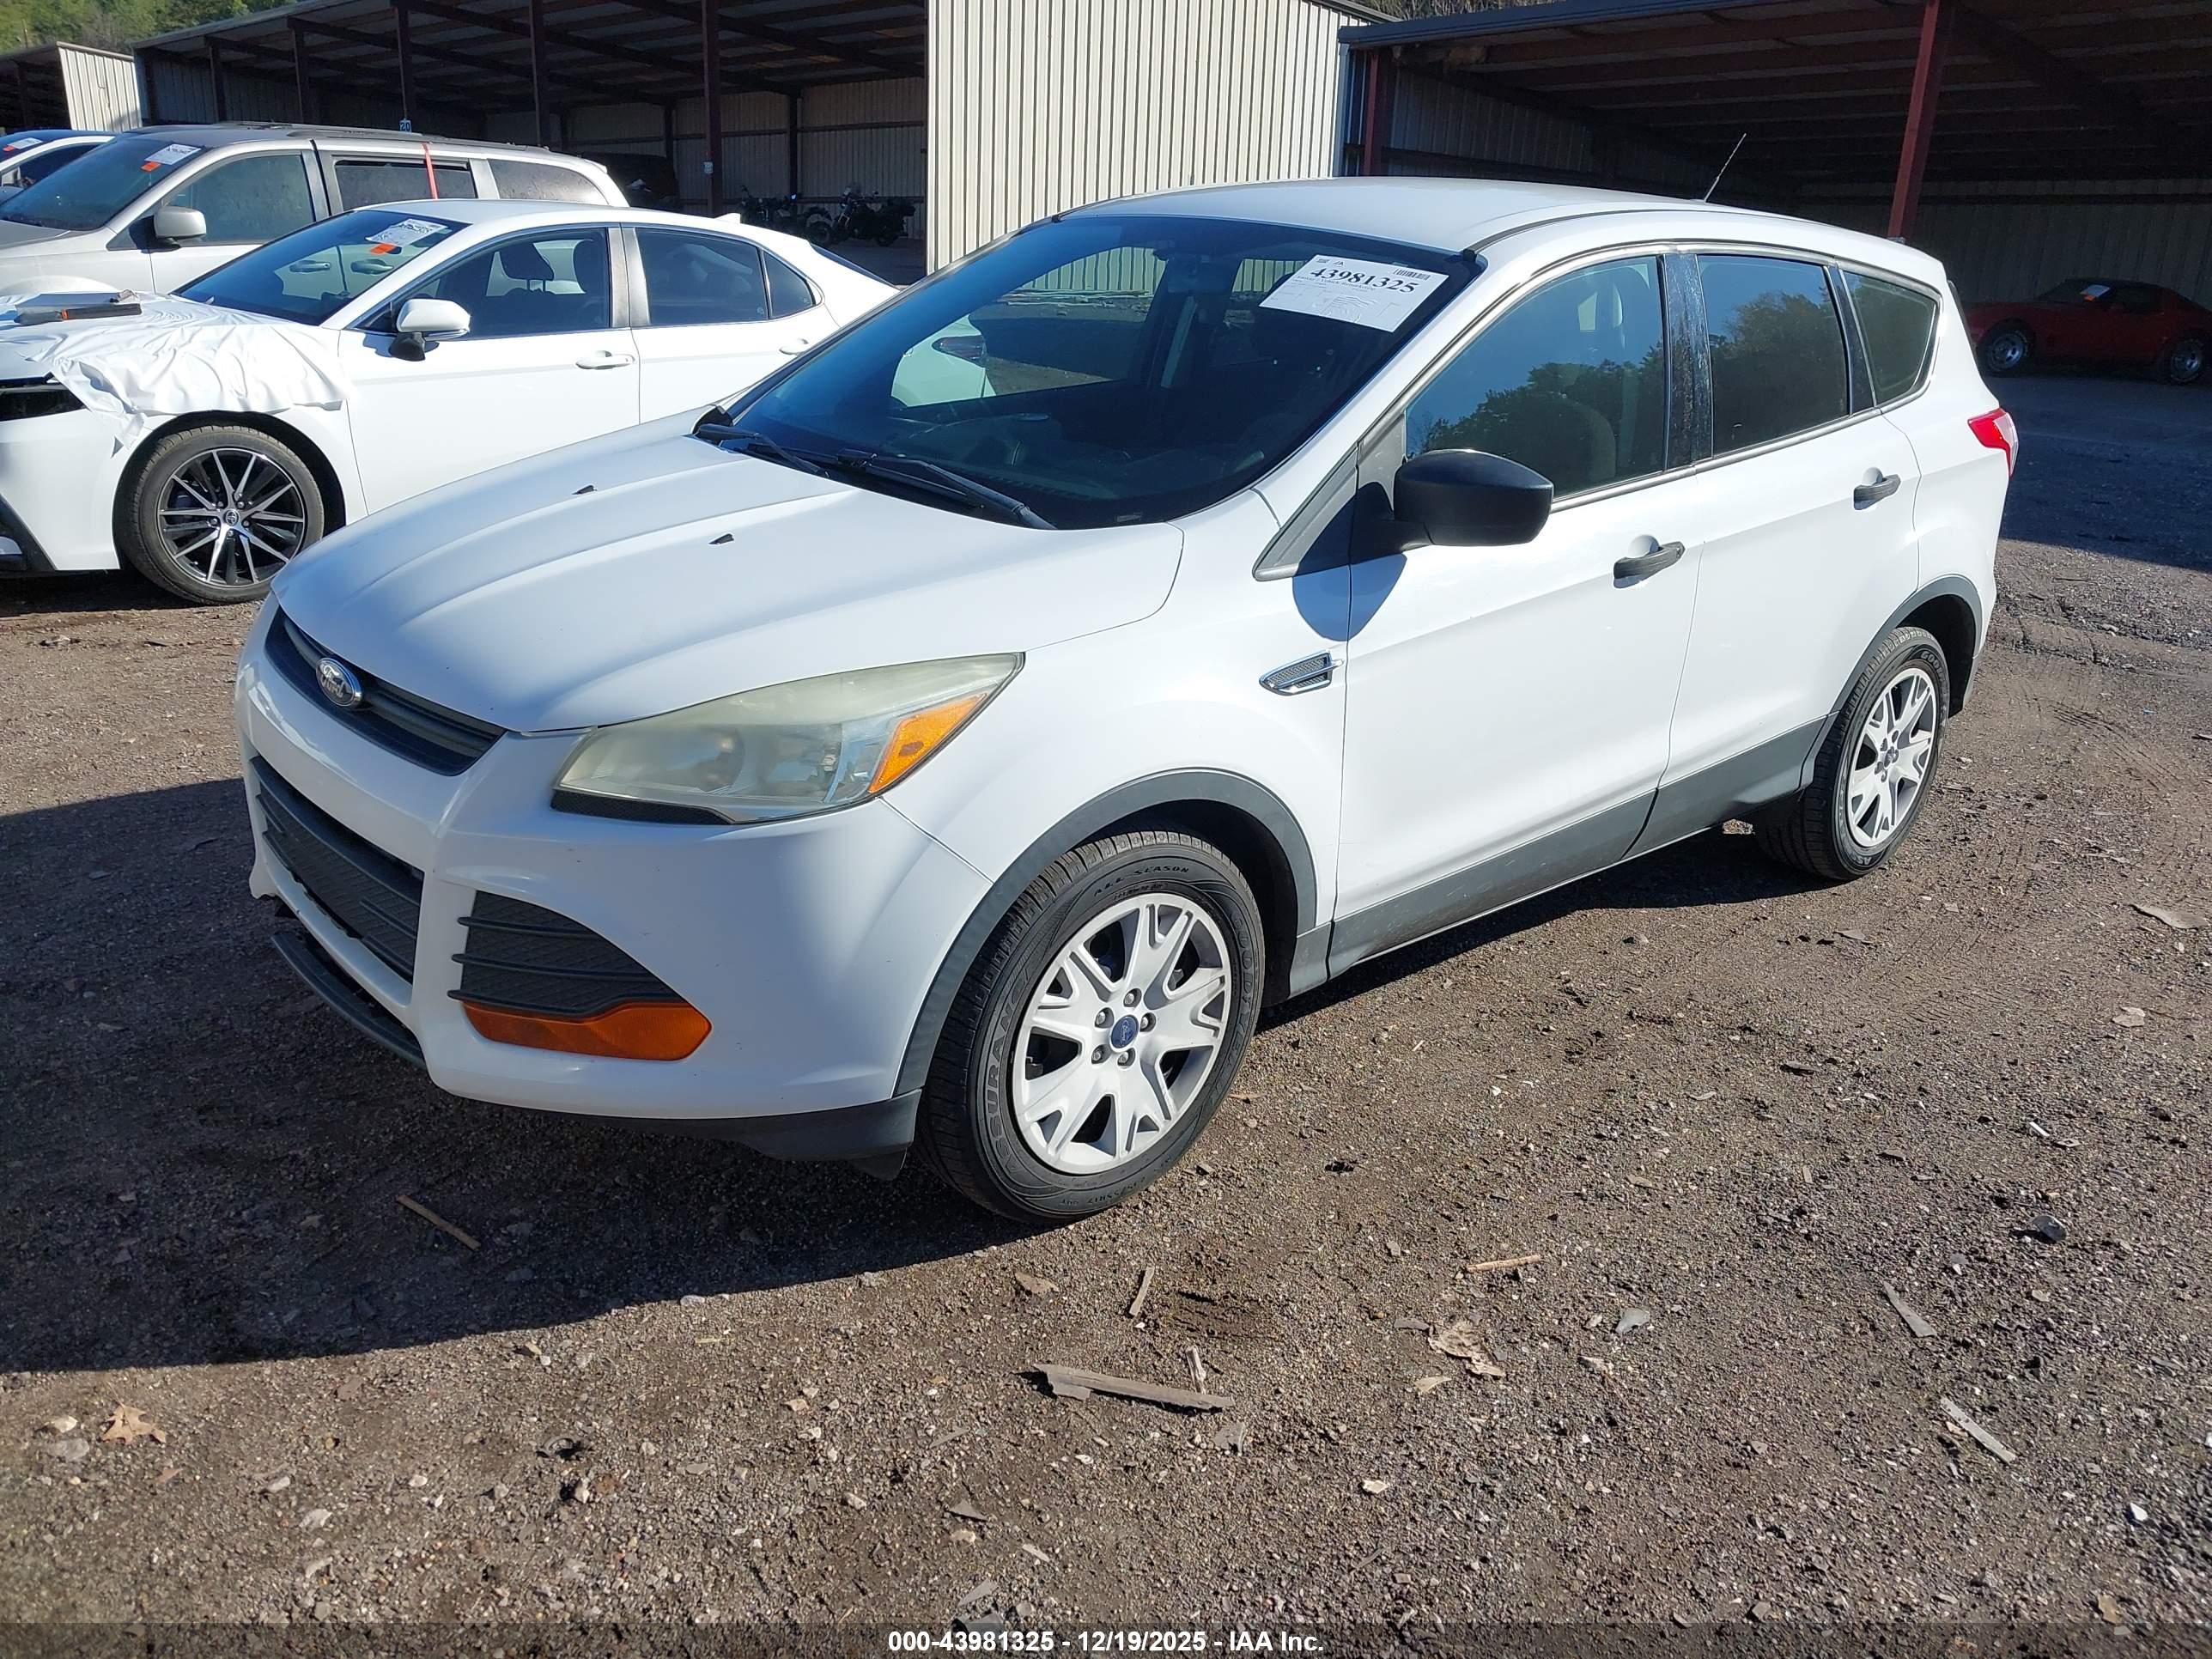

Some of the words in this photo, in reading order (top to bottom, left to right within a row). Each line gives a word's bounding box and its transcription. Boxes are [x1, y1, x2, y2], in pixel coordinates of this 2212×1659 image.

[399, 122, 410, 131] 20
[1310, 268, 1419, 293] 43981325
[320, 664, 345, 698] Ford
